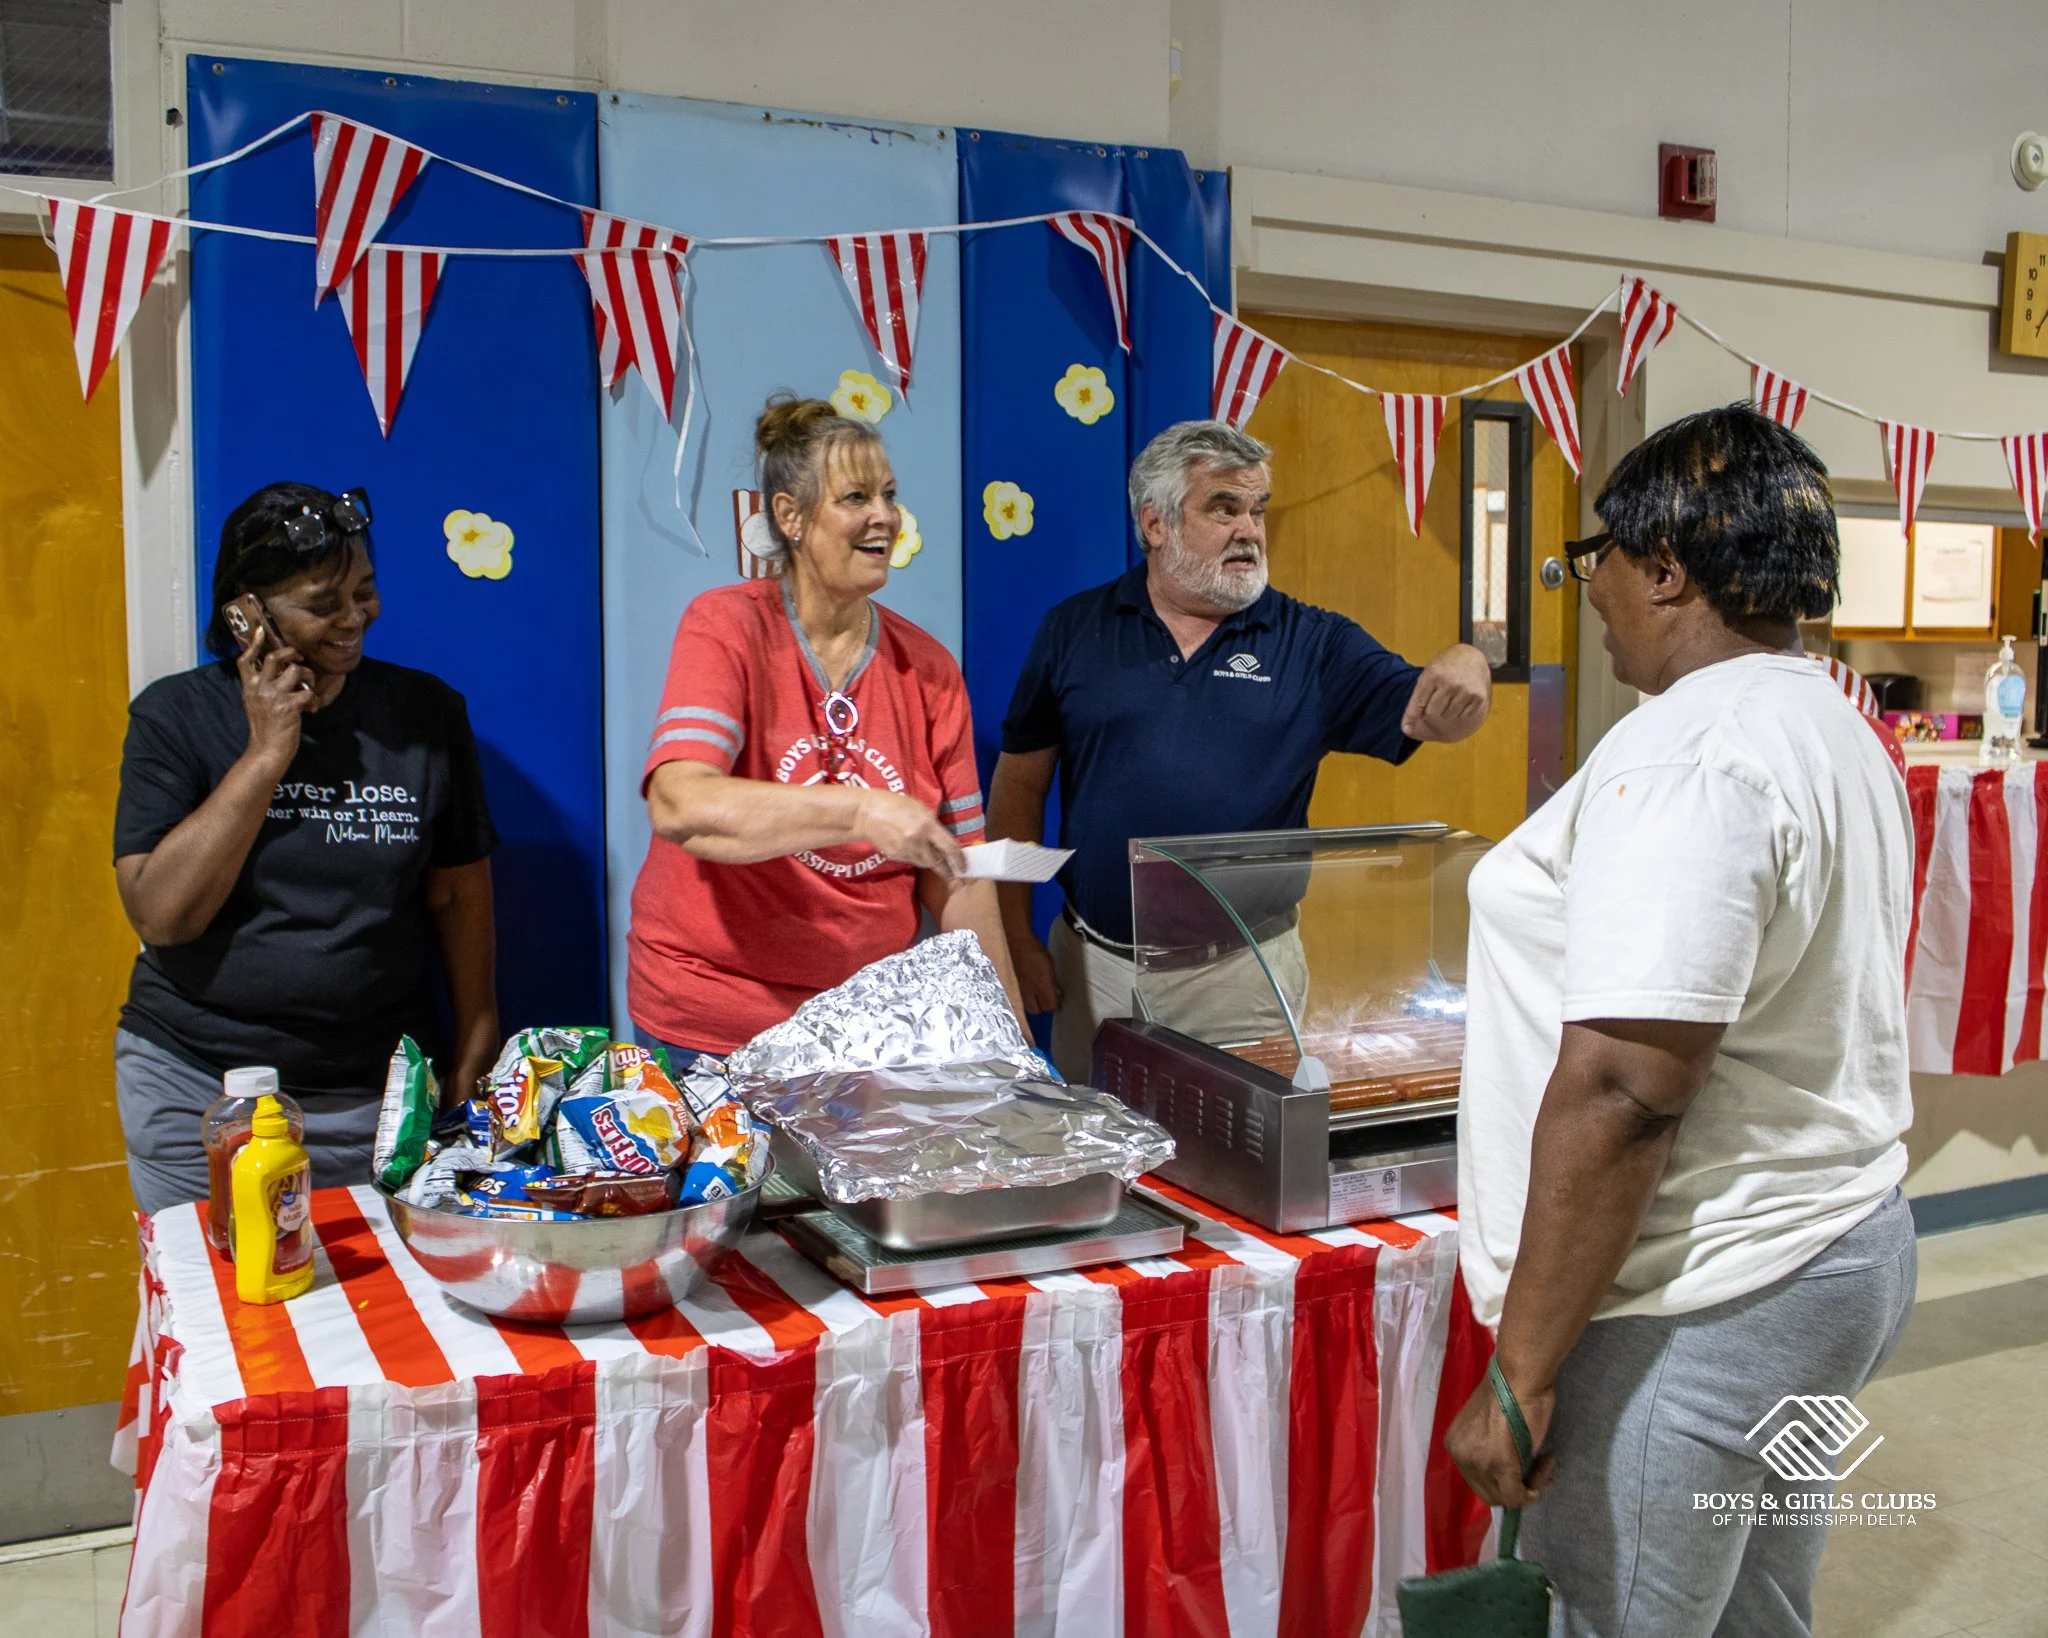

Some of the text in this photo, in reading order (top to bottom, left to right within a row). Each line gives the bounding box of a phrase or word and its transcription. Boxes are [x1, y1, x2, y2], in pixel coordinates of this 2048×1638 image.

[2040, 254, 2046, 267] 11
[2029, 268, 2038, 281] 10
[2027, 288, 2033, 301] 9
[2025, 308, 2032, 322] 8
[776, 738, 812, 783] BOYS
[864, 748, 906, 797] CLUB
[272, 780, 417, 804] ever lose.
[299, 805, 331, 821] win
[334, 810, 354, 822] or
[356, 808, 367, 822] I
[371, 808, 420, 823] learn.
[326, 823, 419, 845] Nelson Mandela
[855, 851, 888, 876] DEL
[609, 1047, 650, 1072] Lay's
[591, 1107, 660, 1173] UFFLES
